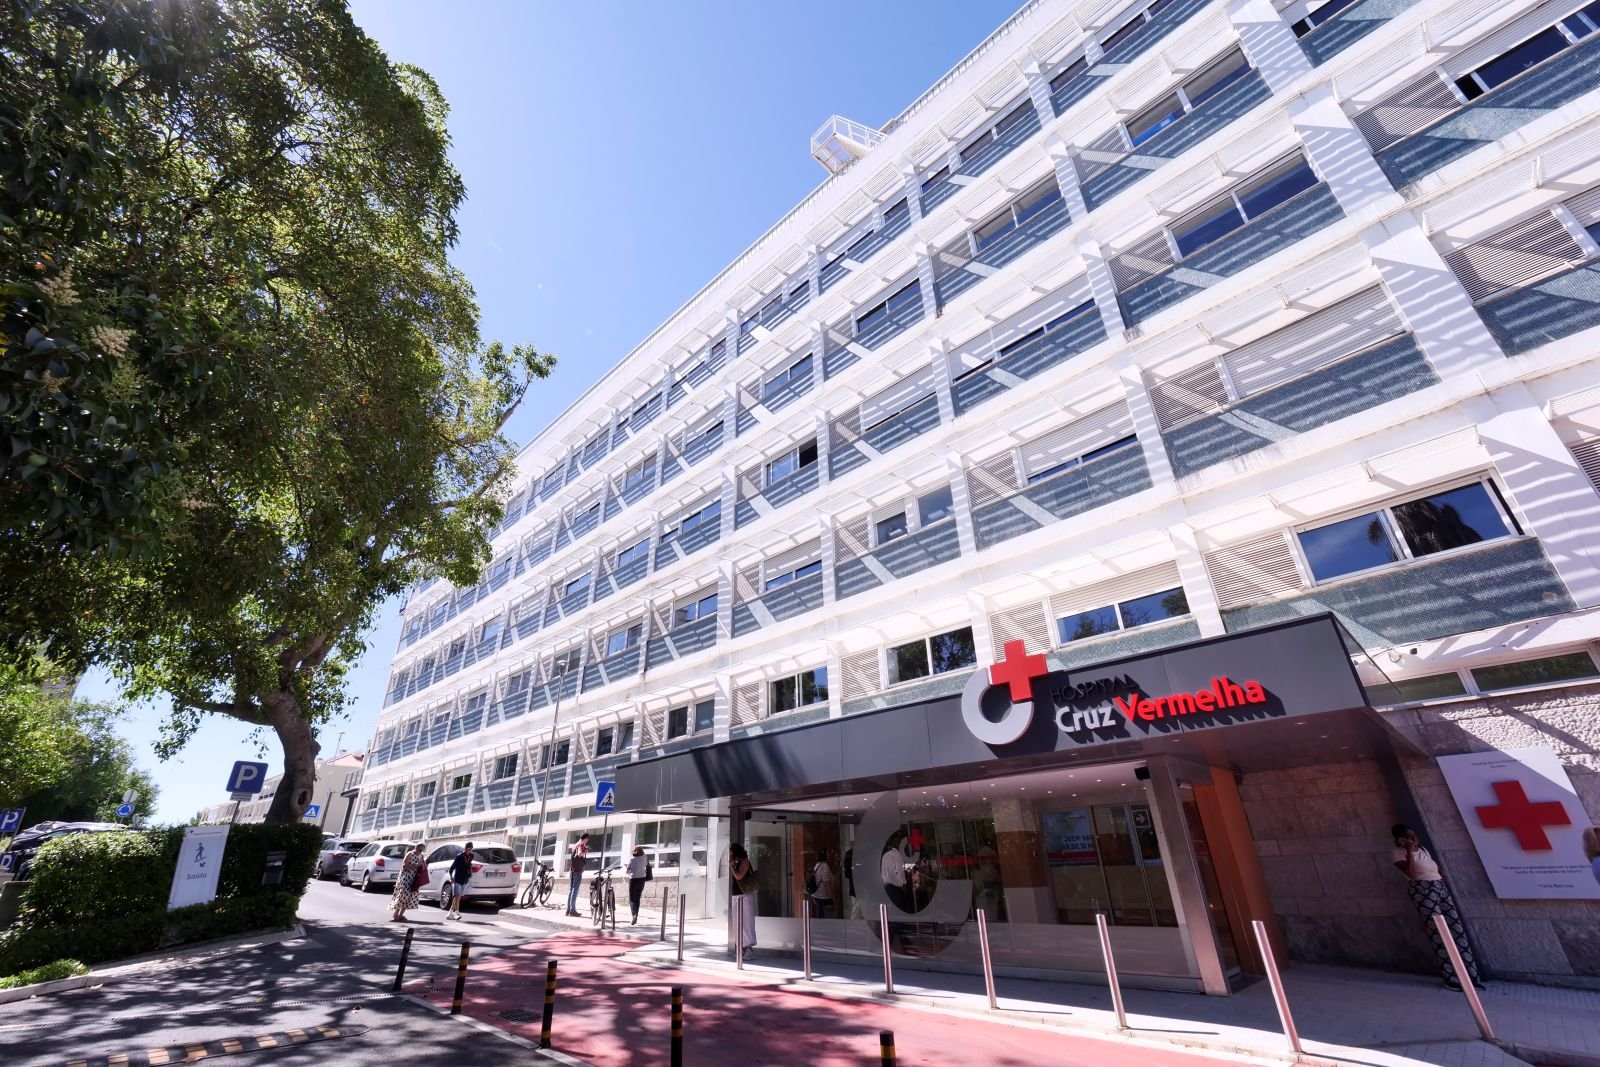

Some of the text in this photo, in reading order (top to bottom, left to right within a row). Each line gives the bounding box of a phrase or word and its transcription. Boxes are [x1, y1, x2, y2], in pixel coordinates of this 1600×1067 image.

[1051, 674, 1137, 702] HOSPITAL
[1055, 674, 1266, 732] Cruz Vermelha
[234, 765, 258, 789] P
[0, 811, 19, 830] P
